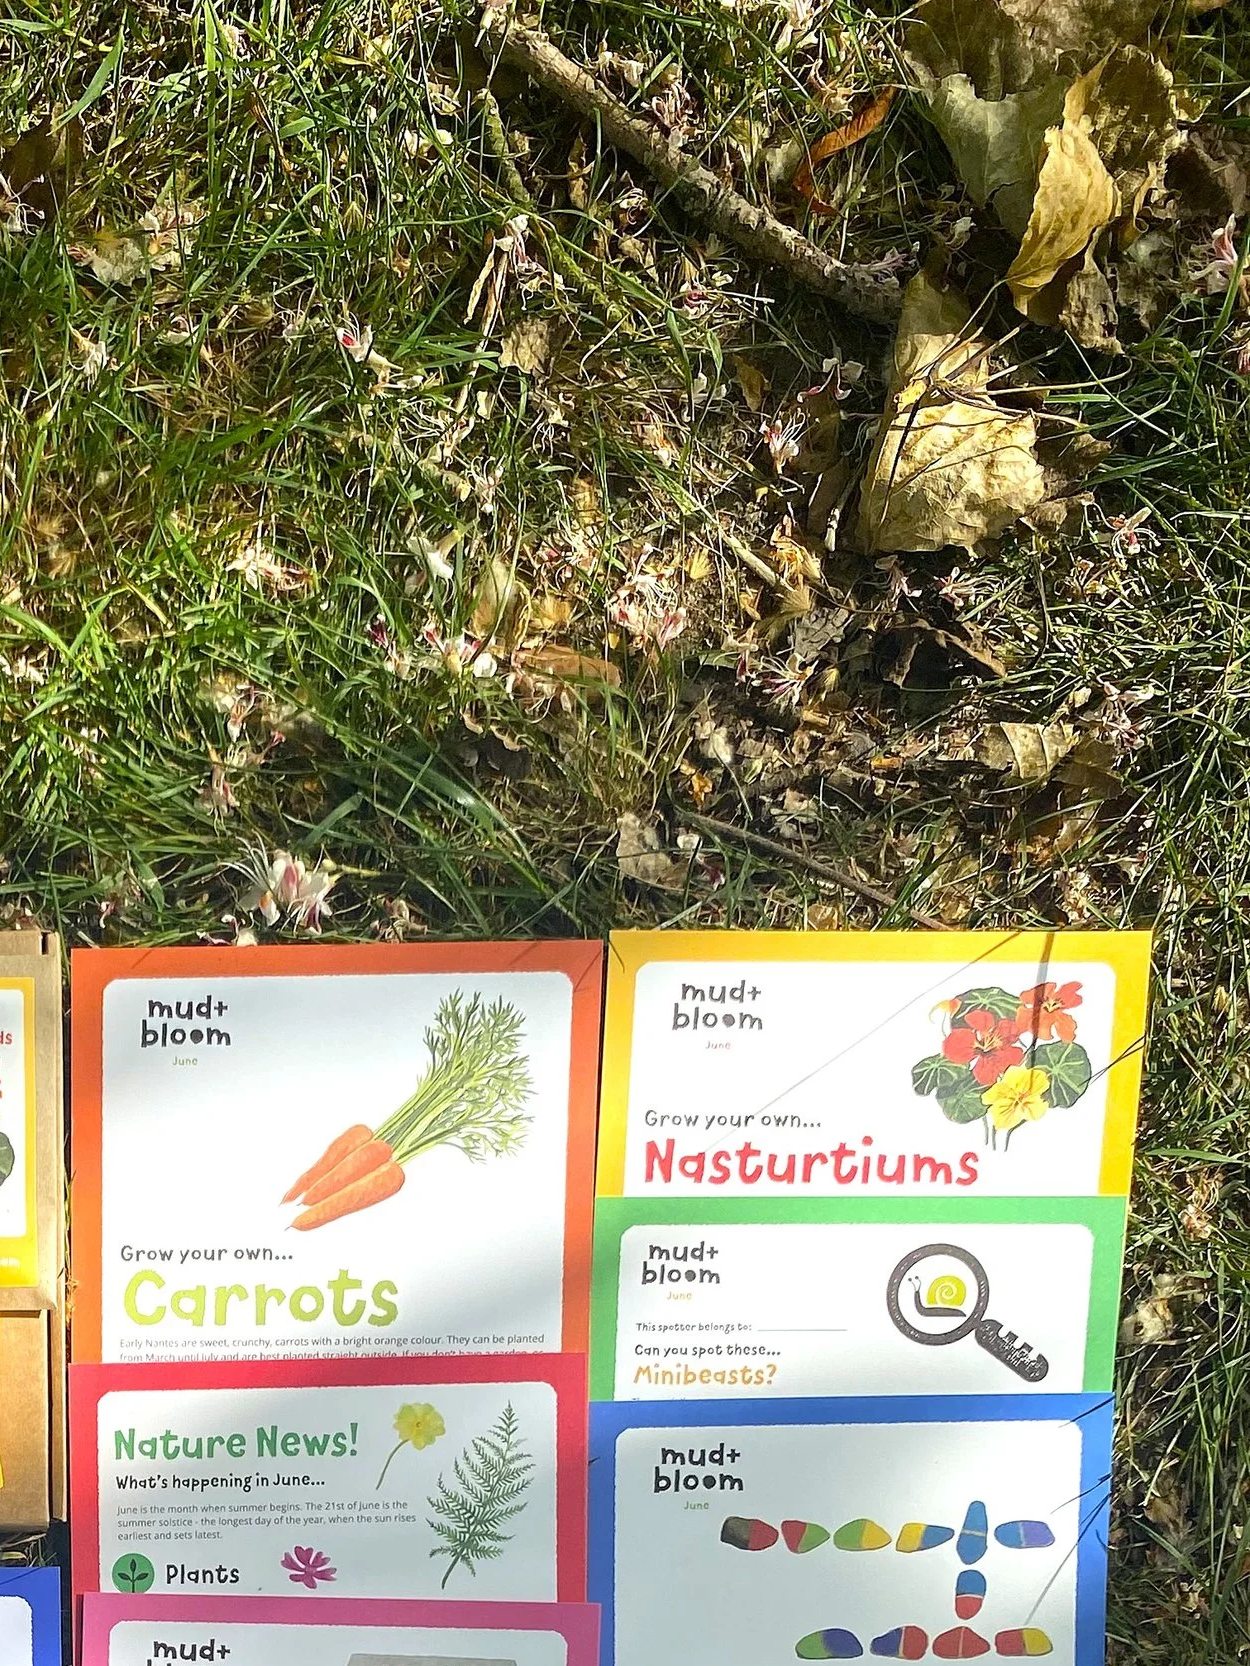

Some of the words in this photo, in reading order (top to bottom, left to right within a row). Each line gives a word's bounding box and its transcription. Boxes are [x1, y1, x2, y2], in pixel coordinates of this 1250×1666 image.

[681, 980, 761, 1004] mud+
[148, 995, 228, 1019] mud+
[672, 1004, 763, 1031] bloom
[142, 1019, 231, 1047] bloom
[706, 1041, 731, 1050] June
[172, 1056, 198, 1066] June
[645, 1111, 699, 1127] Grow
[704, 1111, 755, 1130] your
[761, 1111, 821, 1128] own...
[645, 1136, 979, 1186] Nasturtiums
[120, 1246, 174, 1261] Grow
[179, 1247, 228, 1264] your
[235, 1246, 293, 1261] own...
[649, 1241, 719, 1262] mud+
[642, 1262, 720, 1285] bloom
[123, 1268, 399, 1327] Carrots
[667, 1291, 692, 1301] June
[636, 1323, 656, 1331] This
[658, 1323, 695, 1333] spotter
[699, 1323, 734, 1334] belongs
[738, 1323, 752, 1331] to:
[635, 1344, 660, 1355] Can
[664, 1346, 687, 1357] you
[692, 1345, 722, 1358] spot
[727, 1344, 781, 1355] these...
[634, 1363, 777, 1385] Minibeasts?
[114, 1428, 246, 1461] Nature
[256, 1422, 360, 1457] News!
[661, 1442, 740, 1466] mud+
[115, 1474, 168, 1489] What's
[172, 1473, 252, 1492] happening
[256, 1474, 269, 1487] in
[273, 1472, 325, 1487] June...
[654, 1466, 744, 1493] bloom
[683, 1501, 709, 1510] June
[117, 1531, 150, 1540] earliest
[154, 1531, 171, 1540] and
[195, 1530, 222, 1539] latest.
[165, 1564, 240, 1584] Plants
[153, 1638, 231, 1662] mud+
